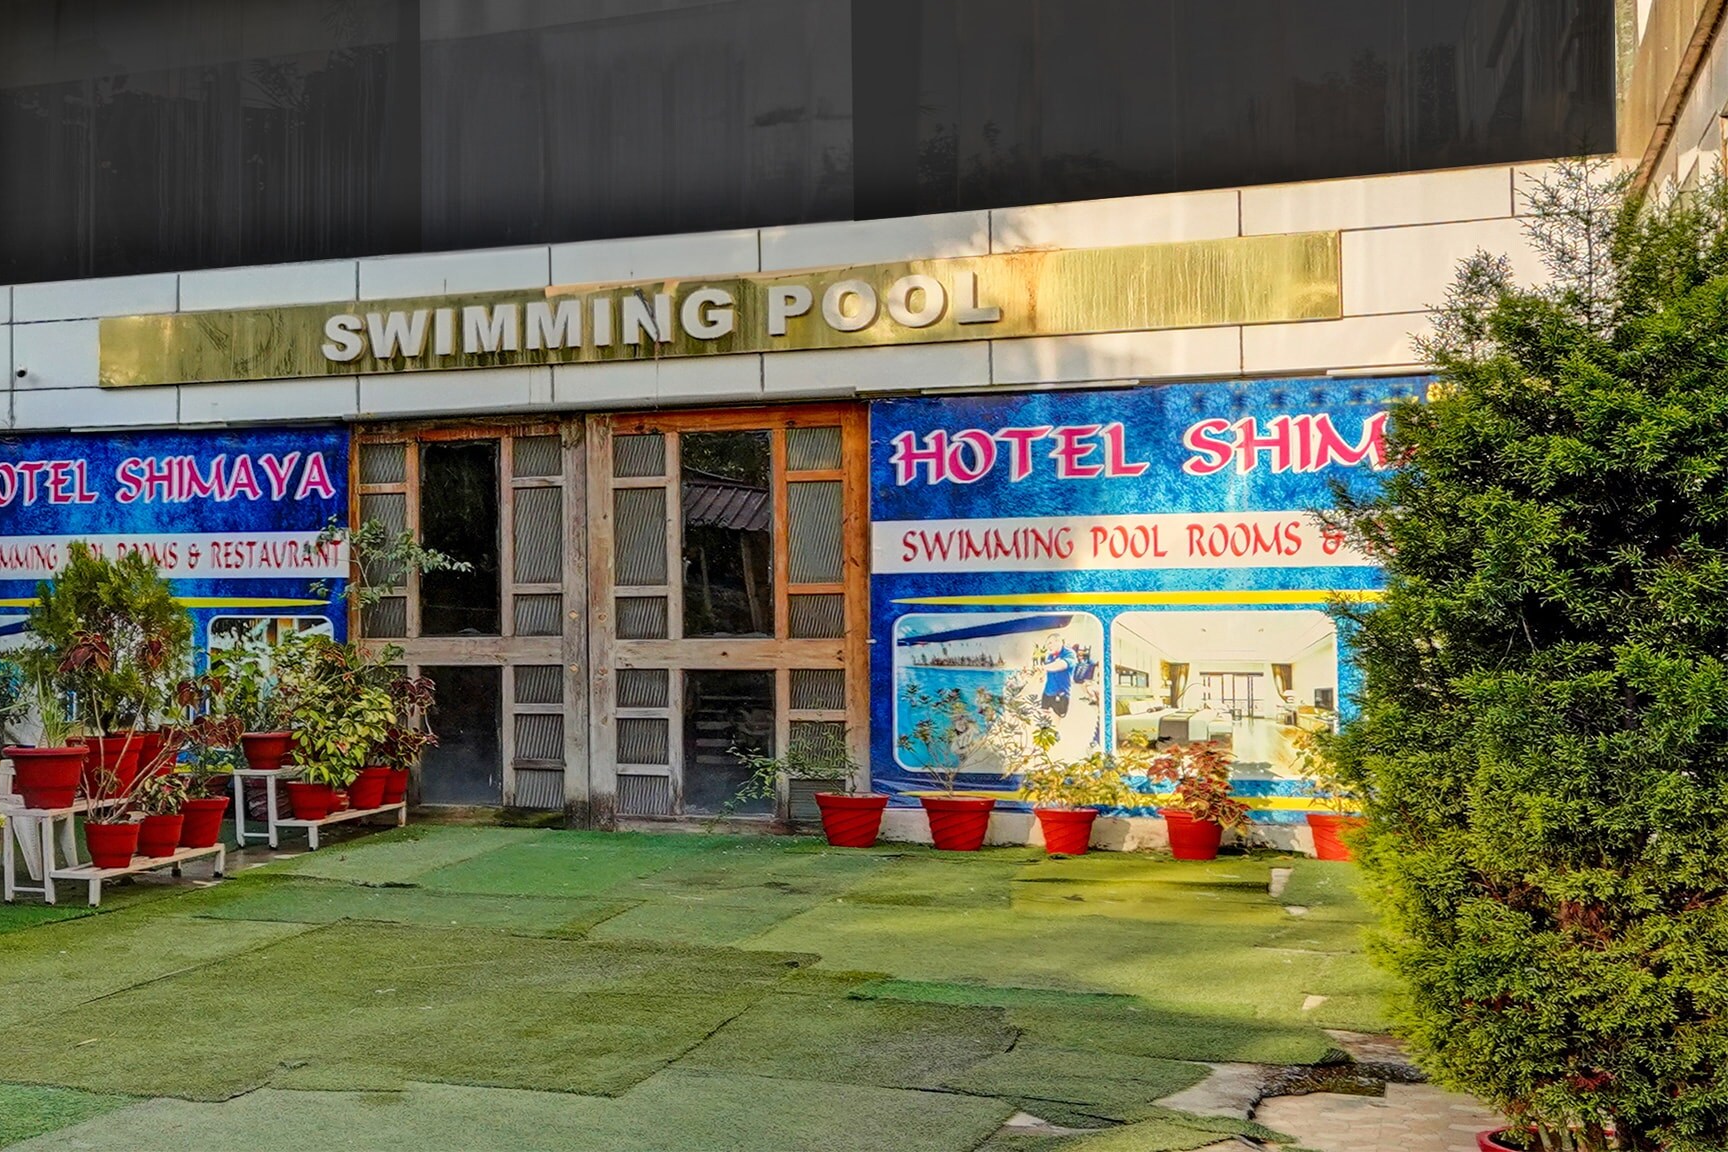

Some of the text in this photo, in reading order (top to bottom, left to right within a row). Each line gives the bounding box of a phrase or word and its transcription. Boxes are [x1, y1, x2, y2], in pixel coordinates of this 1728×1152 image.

[321, 270, 1002, 362] SWIMMING POOL
[890, 411, 1419, 487] HOTEL SHIM
[115, 450, 337, 504] SHIMAYA
[210, 540, 342, 570] RESTAURANT
[901, 524, 1075, 564] SWIMMING
[1089, 523, 1168, 560] POOL
[1186, 520, 1303, 558] ROOMS
